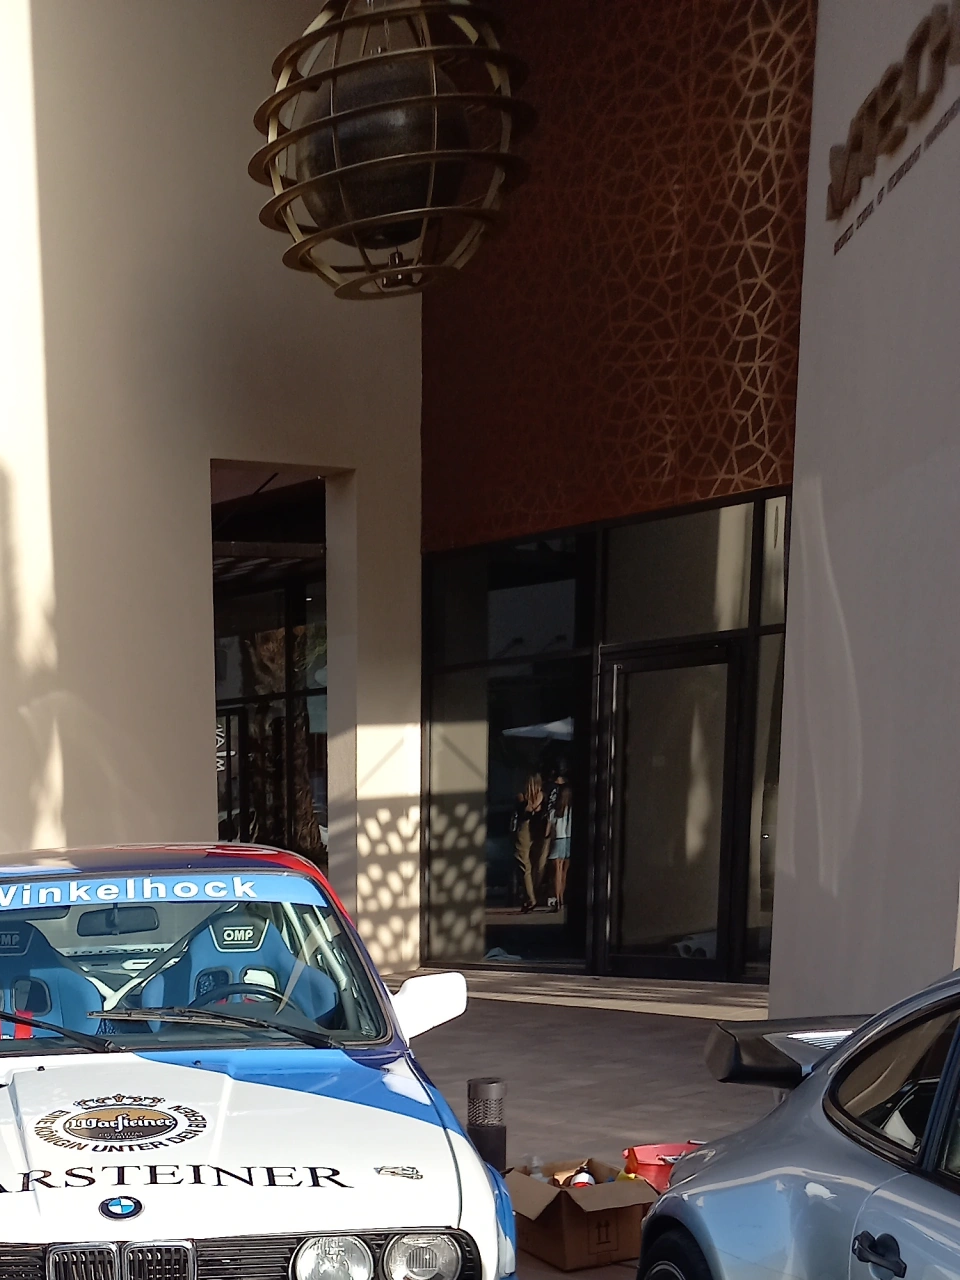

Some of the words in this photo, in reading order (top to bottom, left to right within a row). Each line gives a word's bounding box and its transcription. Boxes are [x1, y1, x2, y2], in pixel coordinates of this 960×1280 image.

[223, 929, 253, 941] OMP
[36, 1109, 71, 1125] EINE
[92, 1140, 169, 1152] UNTER
[165, 1129, 203, 1144] DEN
